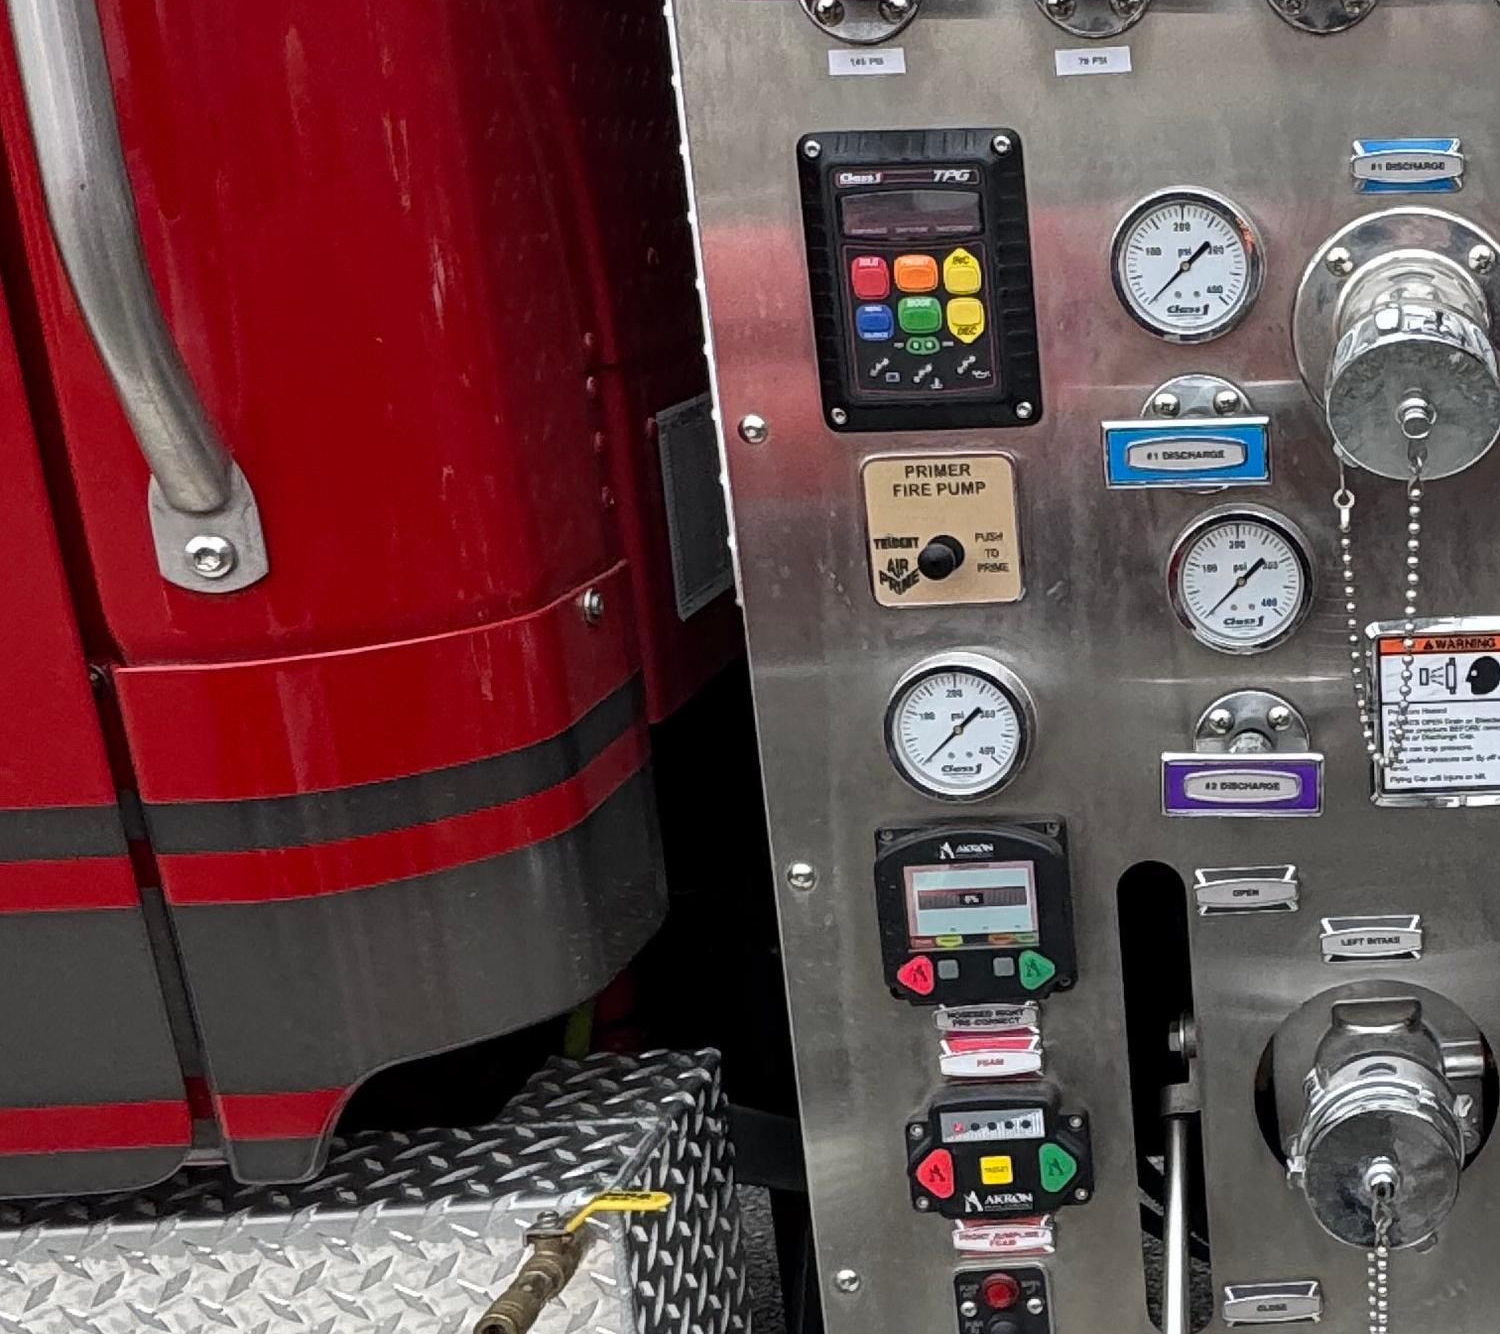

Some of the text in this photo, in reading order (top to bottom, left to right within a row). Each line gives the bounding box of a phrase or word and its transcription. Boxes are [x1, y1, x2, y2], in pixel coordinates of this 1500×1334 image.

[1386, 162, 1445, 171] DISCHARGE
[933, 169, 971, 182] TPG
[1162, 450, 1225, 460] DISCHARGE
[905, 464, 971, 478] PRIMER
[893, 481, 986, 497] FIRE PUMP
[975, 532, 1003, 542] PUSH
[985, 549, 999, 558] TO
[887, 558, 908, 577] AIR
[977, 563, 1009, 572] PRIME
[879, 569, 920, 595] PRIME
[1435, 638, 1496, 650] WARNING
[1220, 782, 1280, 791] DISCHARGE
[956, 843, 994, 853] AKRON
[1233, 889, 1259, 897] OPEN
[1341, 938, 1364, 946] LEFT
[985, 1193, 1033, 1204] AKRON
